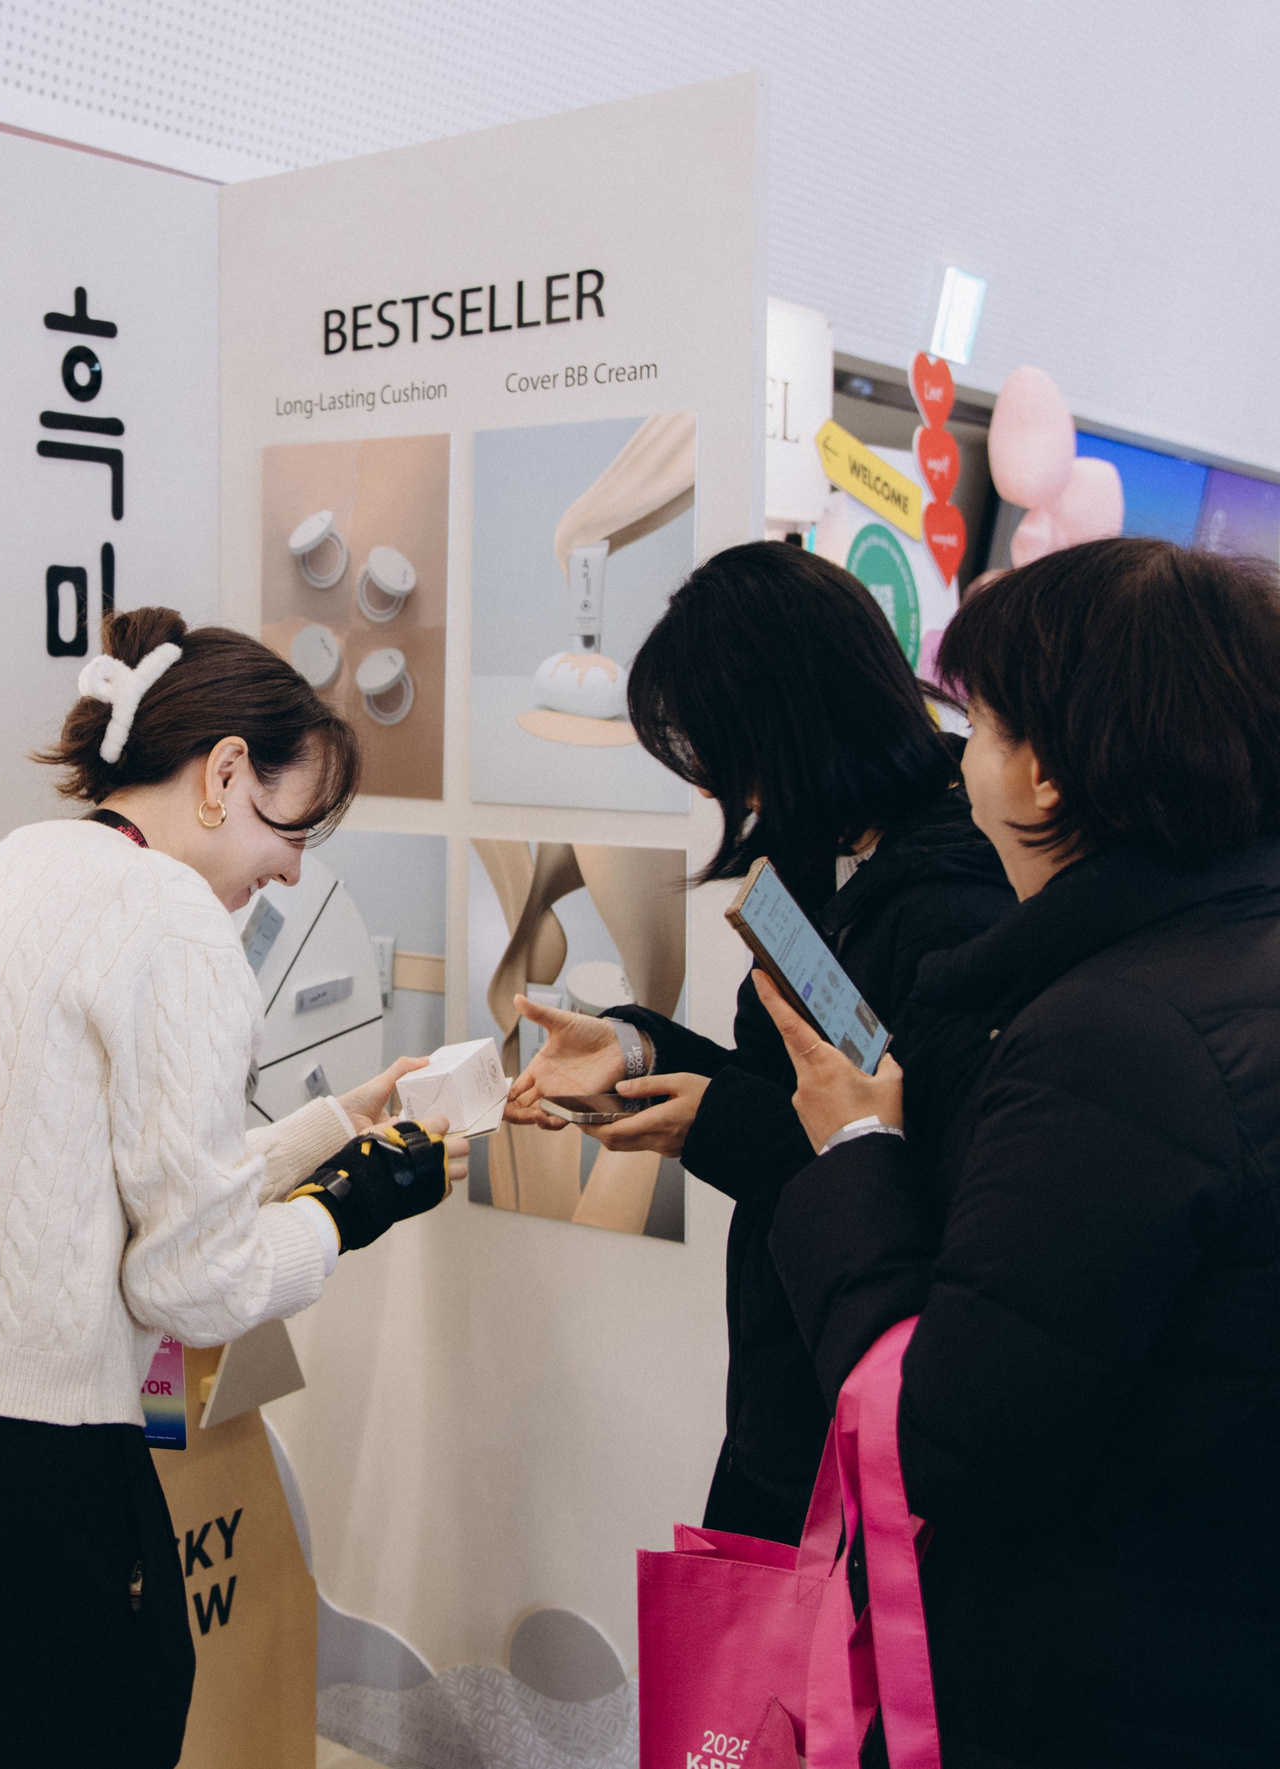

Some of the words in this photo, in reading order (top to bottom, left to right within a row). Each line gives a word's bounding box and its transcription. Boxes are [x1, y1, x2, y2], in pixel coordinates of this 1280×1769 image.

[323, 268, 607, 356] BESTSELLER
[275, 386, 376, 420] Long-Lasting
[380, 380, 448, 405] Cushion
[505, 370, 559, 394] Cover
[564, 365, 589, 387] BB
[593, 361, 658, 385] Cream
[847, 454, 910, 516] WELCOME
[175, 1508, 244, 1577] KY
[192, 1574, 238, 1636] W
